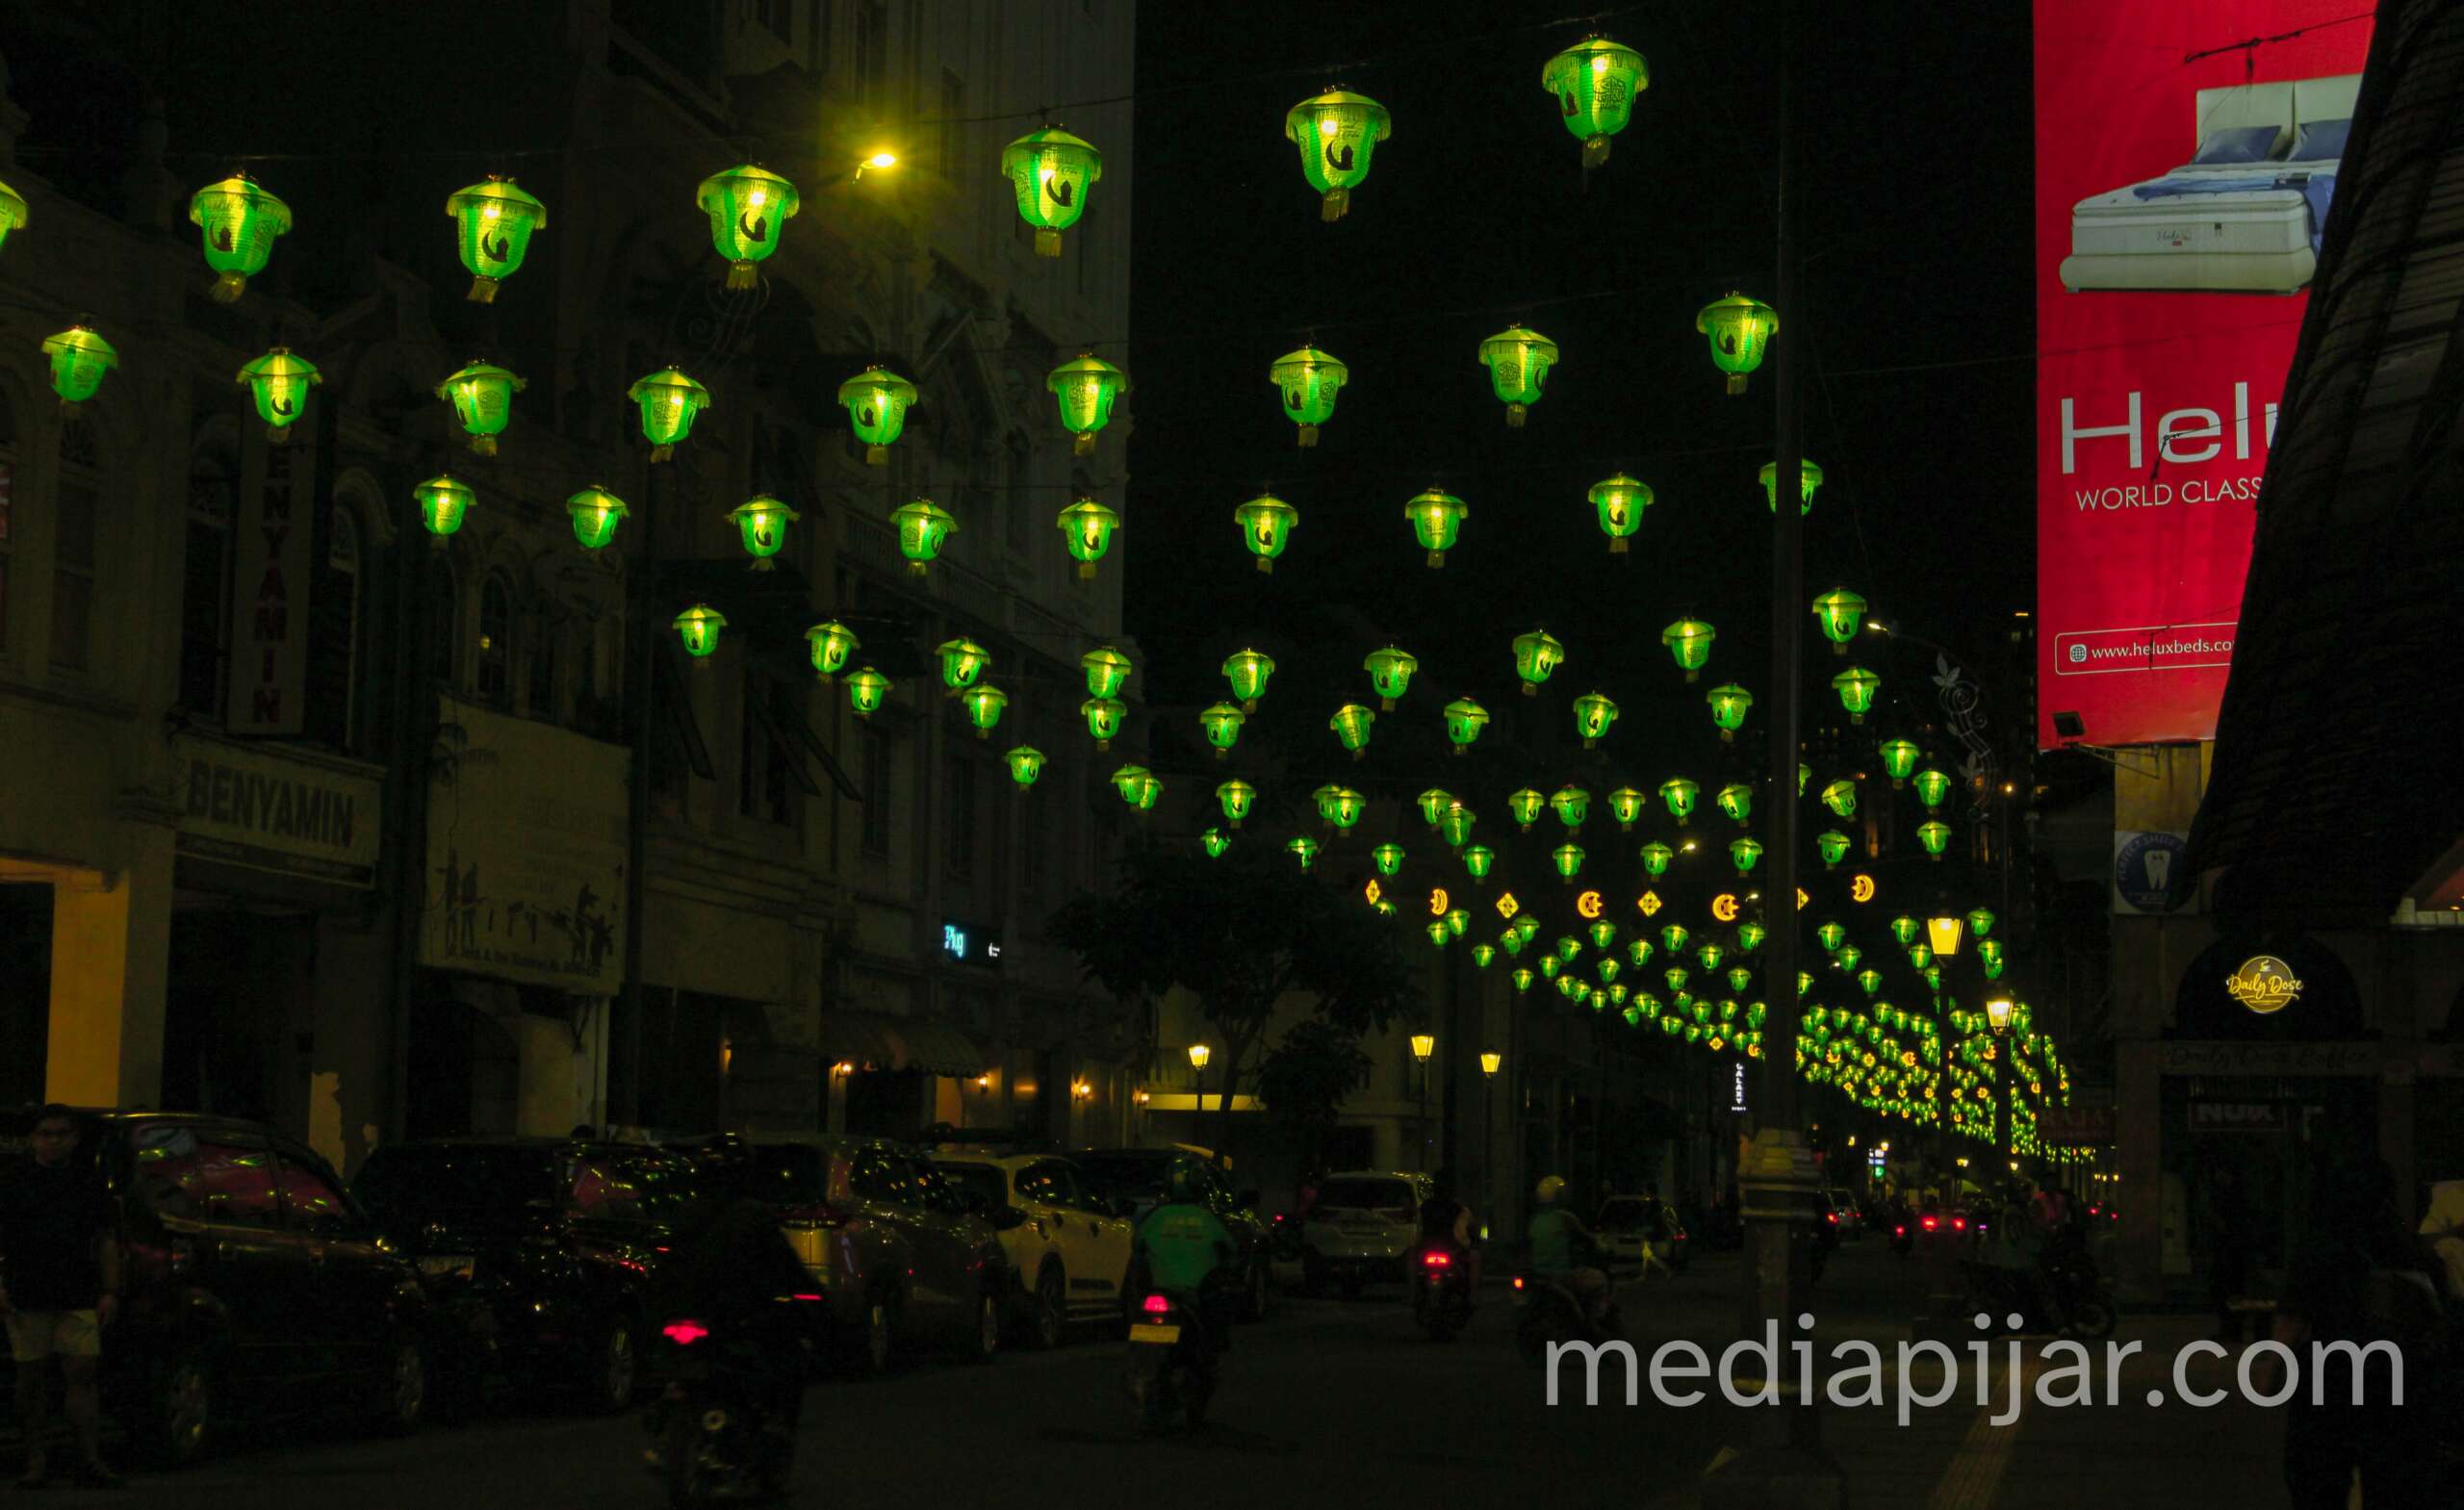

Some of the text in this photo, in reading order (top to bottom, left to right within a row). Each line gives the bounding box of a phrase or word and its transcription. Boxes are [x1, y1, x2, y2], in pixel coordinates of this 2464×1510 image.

[2061, 381, 2278, 474] Hel
[2075, 477, 2263, 511] WORLD CLASS
[253, 445, 293, 725] ENYAMIN
[2092, 639, 2234, 658] www.heluxbeds.co
[192, 760, 354, 848] BENYAMIN
[2225, 972, 2303, 1000] Daily Dose
